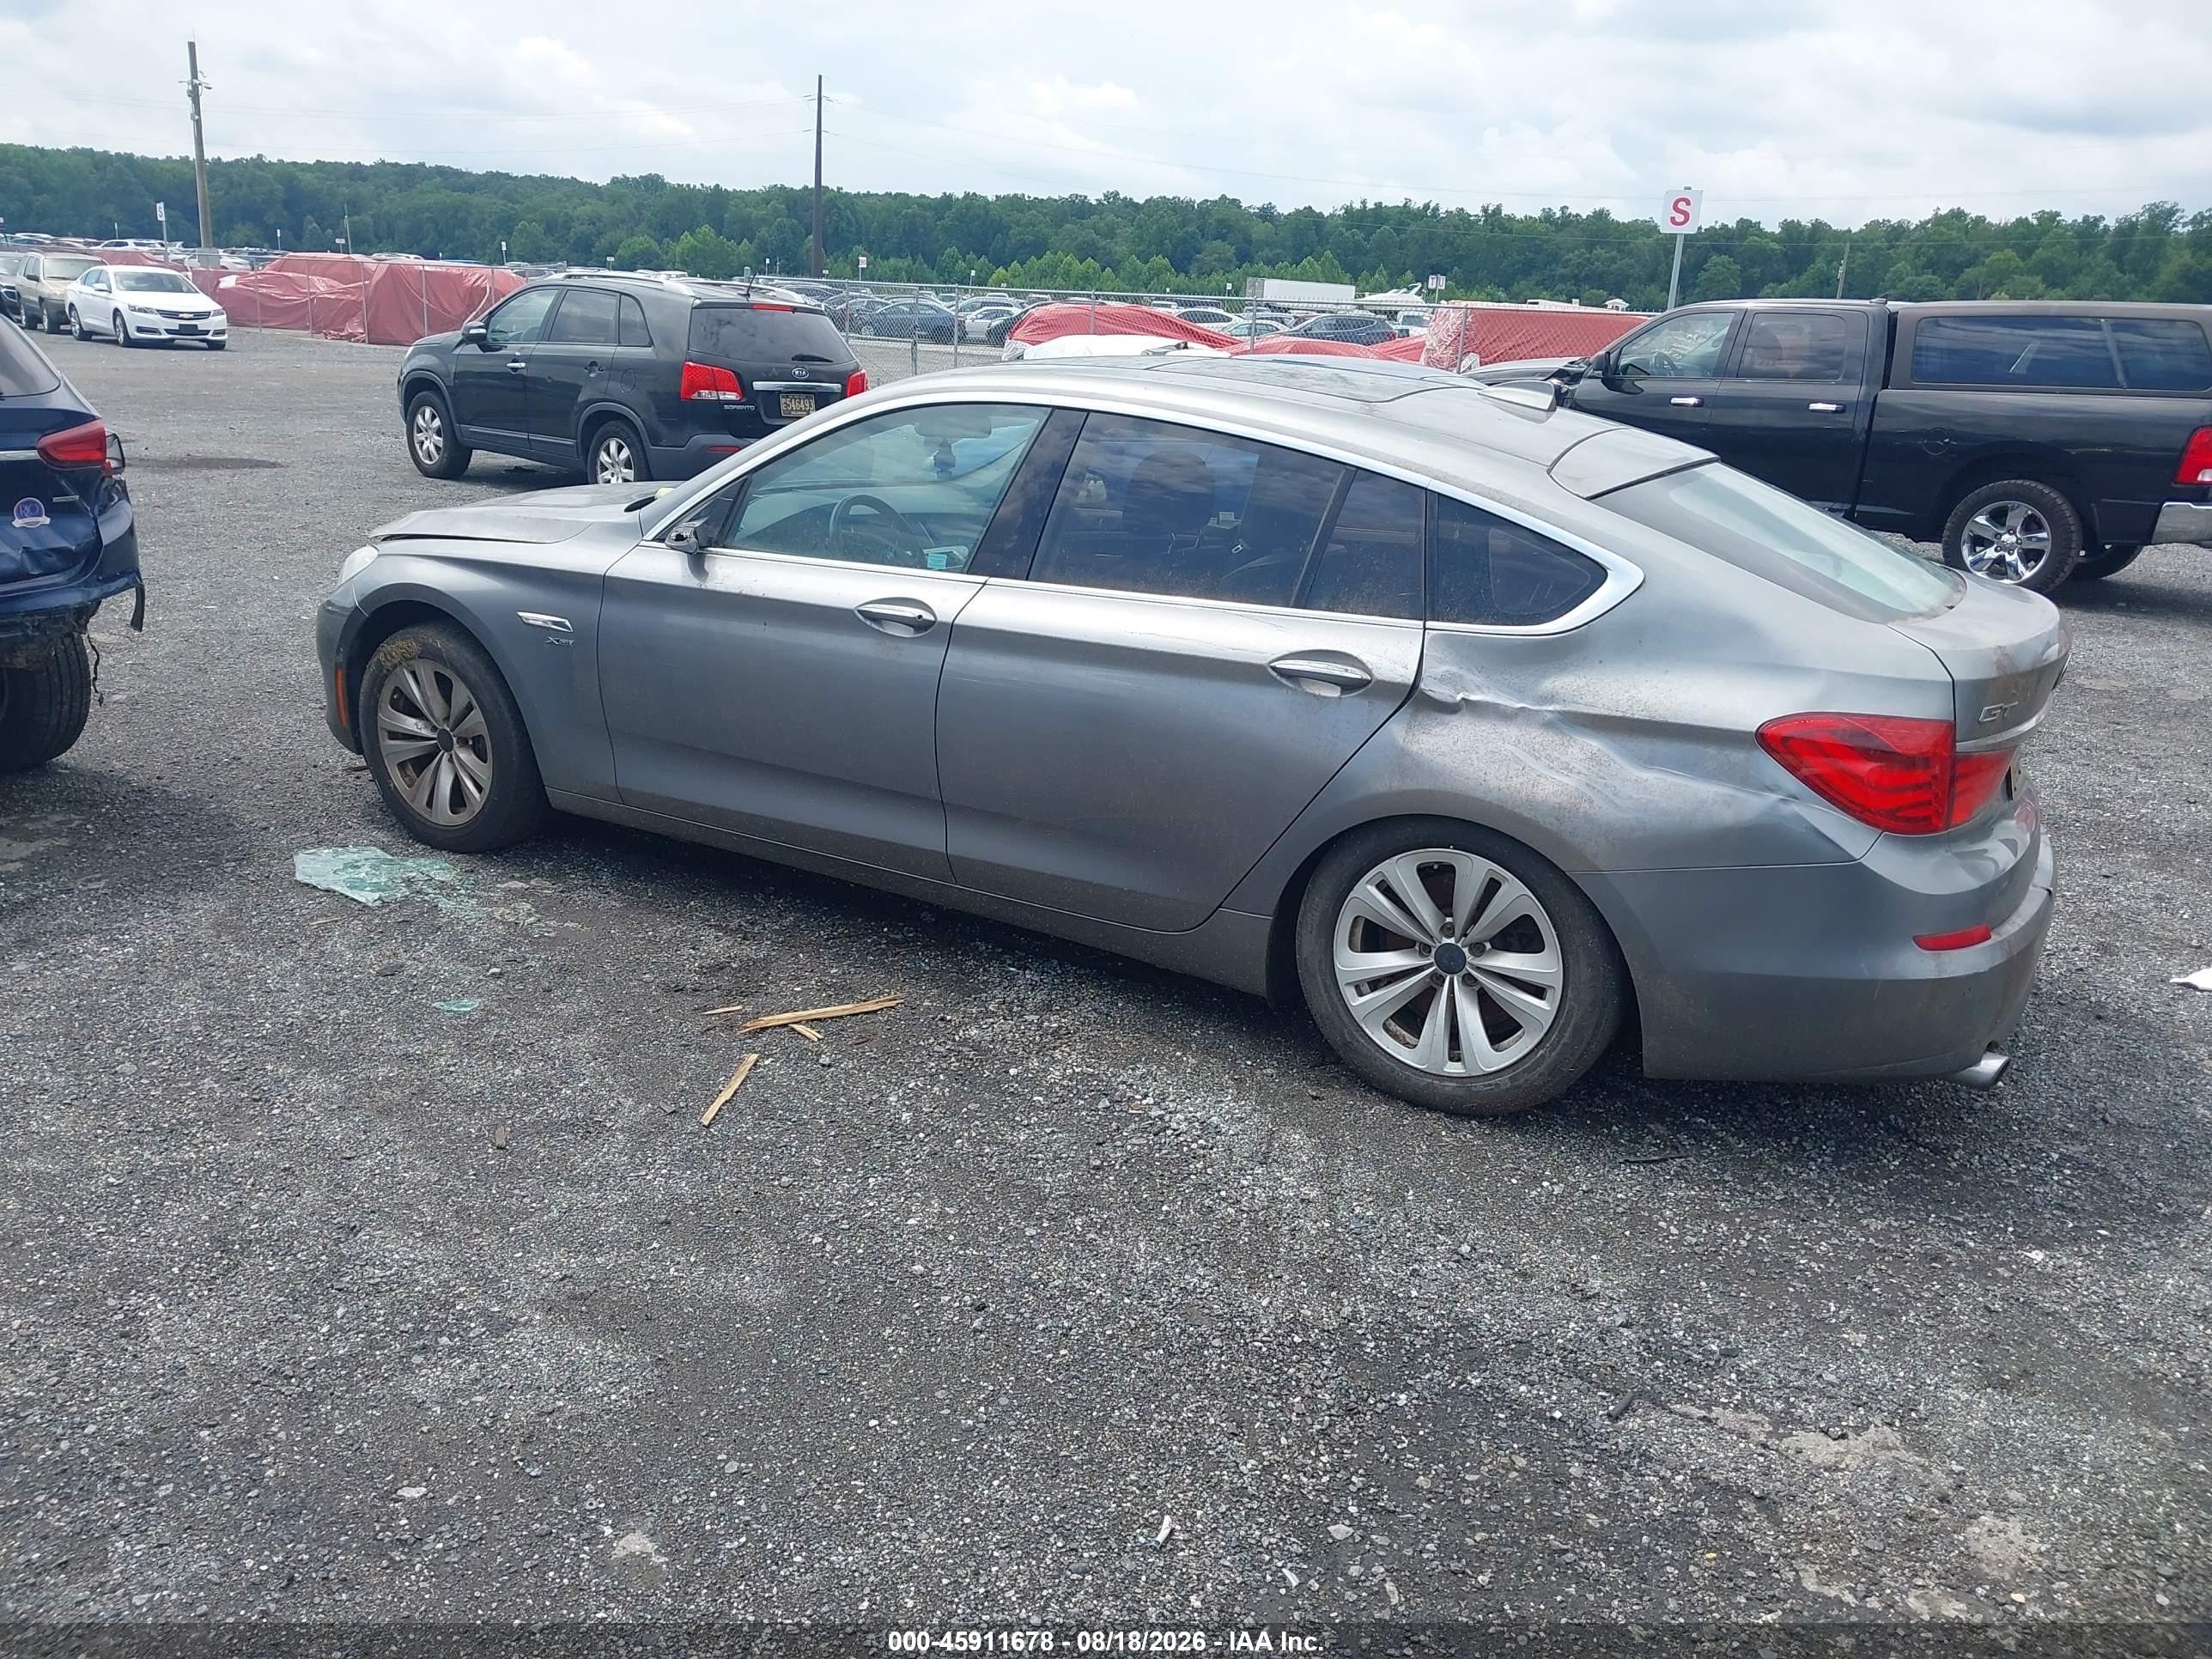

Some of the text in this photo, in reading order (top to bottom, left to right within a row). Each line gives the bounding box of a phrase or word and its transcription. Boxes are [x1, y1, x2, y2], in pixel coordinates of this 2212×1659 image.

[158, 205, 163, 218] S
[1669, 197, 1692, 227] S
[1978, 702, 2019, 722] GT
